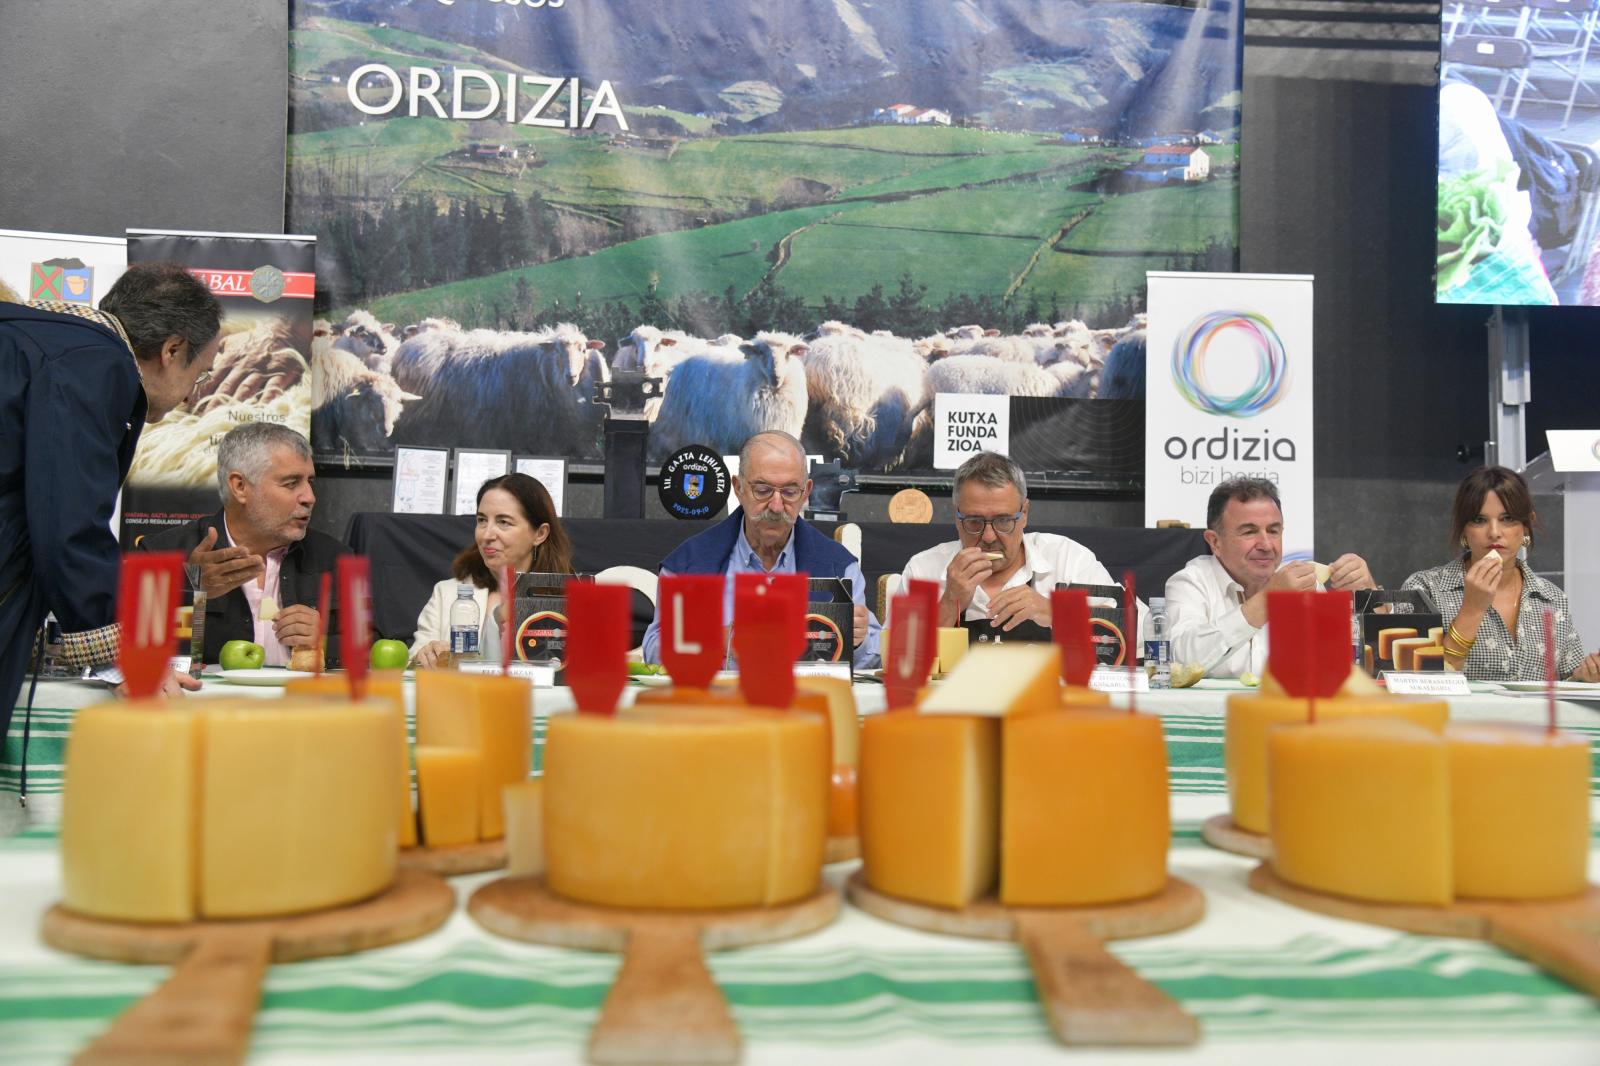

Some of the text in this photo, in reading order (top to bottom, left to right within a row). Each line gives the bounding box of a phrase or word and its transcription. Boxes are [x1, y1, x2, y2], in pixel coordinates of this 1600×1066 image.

[347, 63, 629, 131] ORDIZIA
[228, 410, 286, 422] Nuestros
[948, 411, 998, 424] KUTXA
[948, 425, 997, 439] FUNDA
[948, 439, 982, 452] ZIOA
[1164, 426, 1296, 462] ordizia
[668, 452, 695, 473] GAZTA
[698, 453, 725, 493] LEHIAKETA
[682, 463, 708, 472] ordizia
[1181, 465, 1214, 485] bizi
[134, 570, 171, 649] N
[673, 592, 702, 655] L
